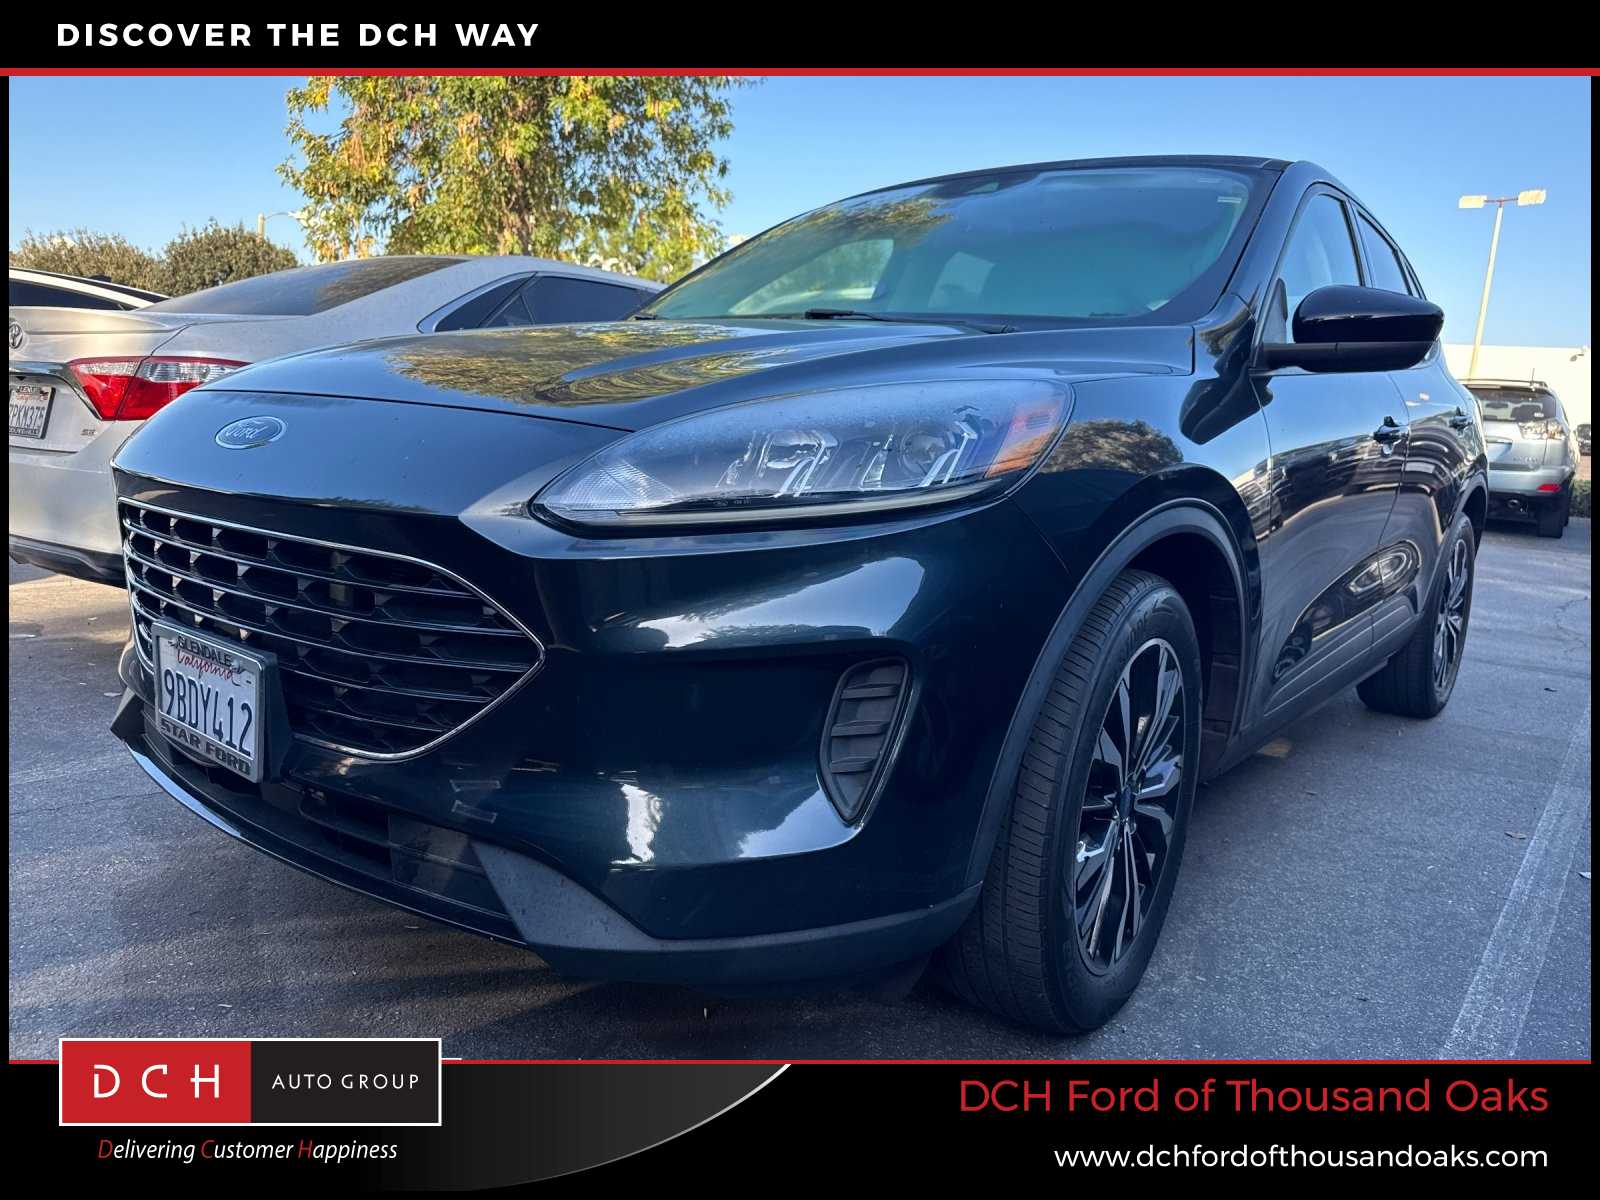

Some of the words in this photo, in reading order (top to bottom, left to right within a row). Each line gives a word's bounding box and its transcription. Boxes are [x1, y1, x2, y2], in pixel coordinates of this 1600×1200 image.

[177, 635, 232, 667] GLENDALE
[163, 668, 253, 757] 9BDY412
[160, 719, 200, 749] STAR
[205, 742, 251, 774] FORD
